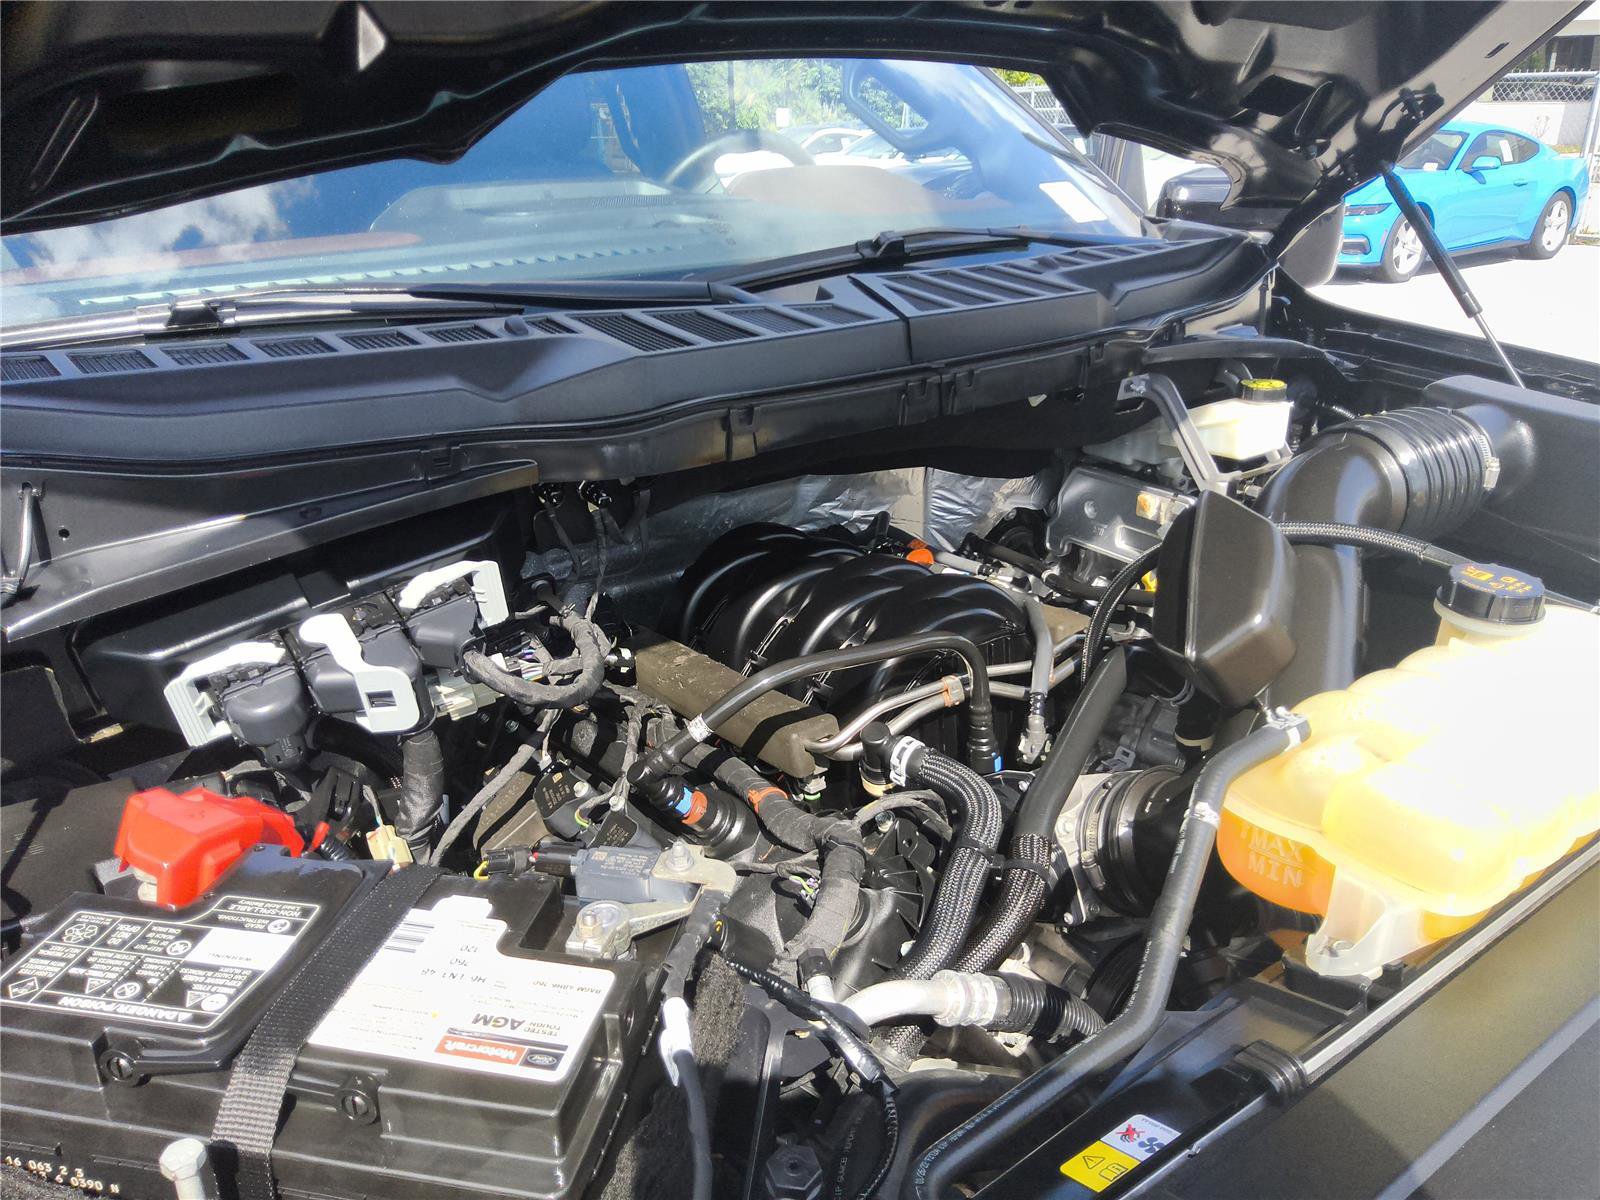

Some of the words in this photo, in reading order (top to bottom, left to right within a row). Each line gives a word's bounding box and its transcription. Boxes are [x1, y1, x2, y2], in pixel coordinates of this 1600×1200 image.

[1247, 850, 1303, 889] MIN
[228, 904, 301, 917] NON-SPILLABLE
[59, 996, 178, 1020] DANGER/POISON
[472, 1014, 525, 1030] AGM
[530, 1022, 560, 1031] TOUGH
[524, 1028, 558, 1037] TESTED
[445, 1041, 517, 1060] Motorcraft
[27, 1160, 52, 1173] 063
[60, 1166, 68, 1176] 2
[74, 1168, 84, 1178] 3
[55, 1175, 64, 1184] 6
[69, 1177, 104, 1191] 0390
[109, 1184, 120, 1194] N
